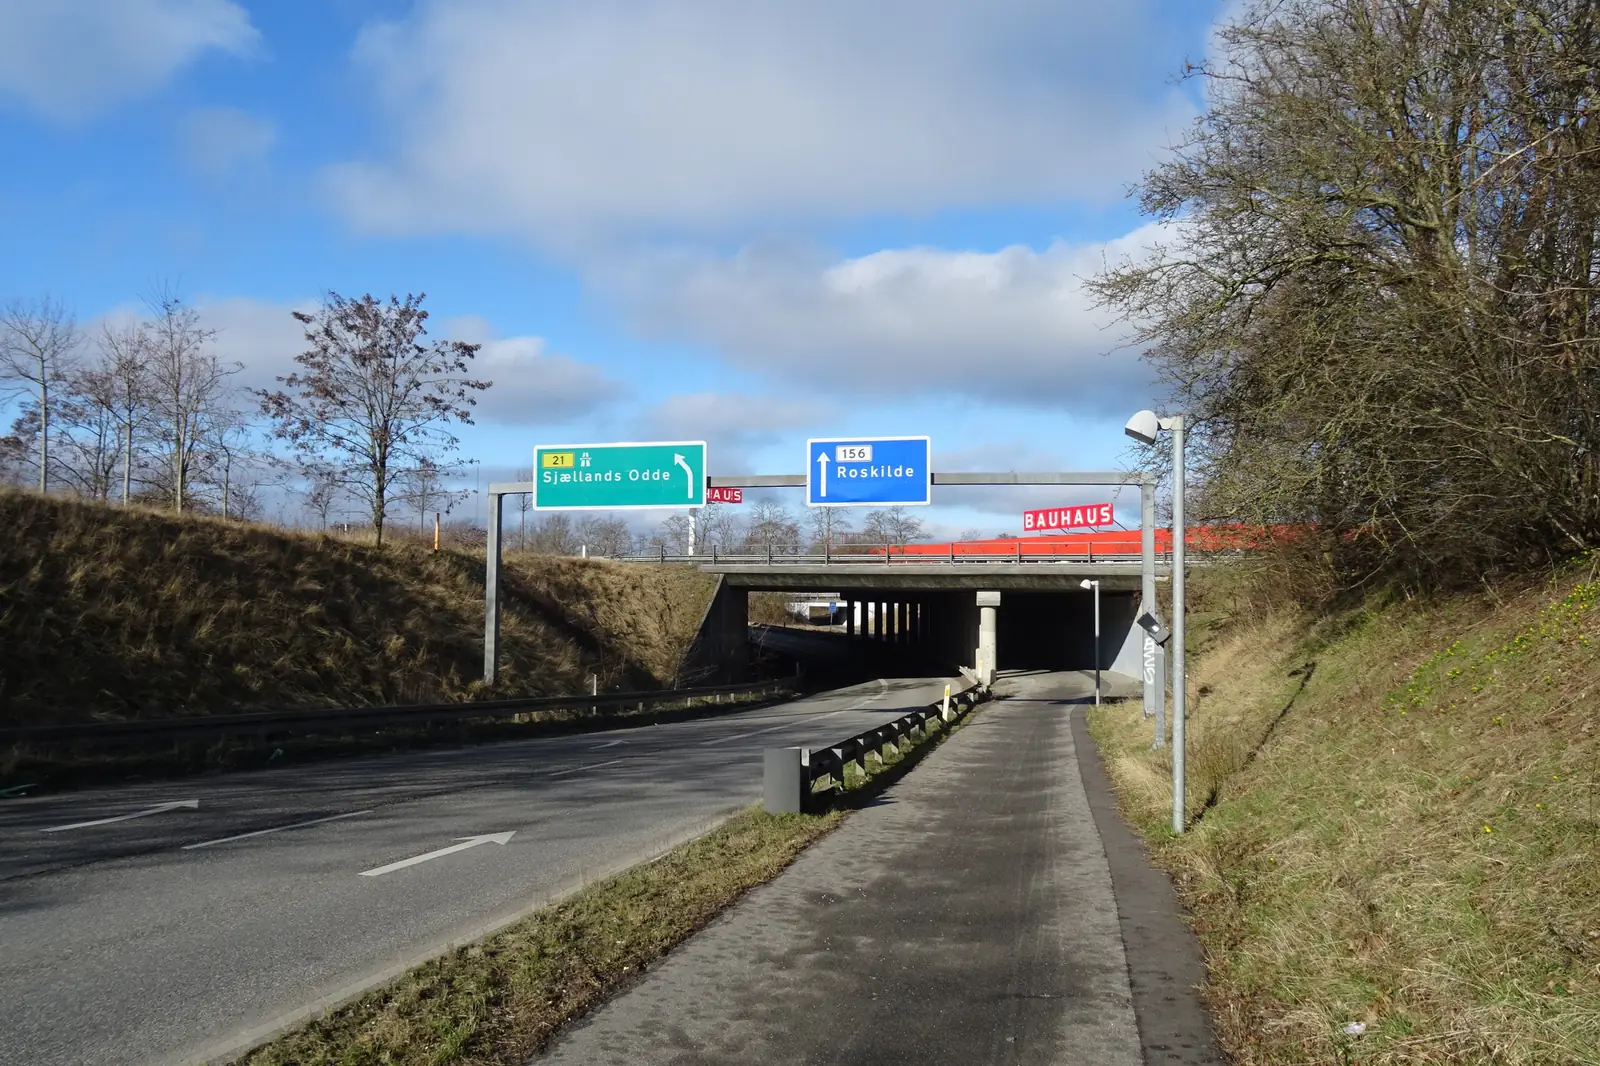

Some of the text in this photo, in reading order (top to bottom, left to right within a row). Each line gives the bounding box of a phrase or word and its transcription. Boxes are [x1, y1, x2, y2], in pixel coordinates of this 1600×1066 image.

[552, 456, 565, 465] 21
[843, 449, 866, 459] 156
[543, 469, 671, 485] Sjællands Odde
[837, 465, 914, 478] Roskilde
[1025, 506, 1111, 528] BAUHAUS
